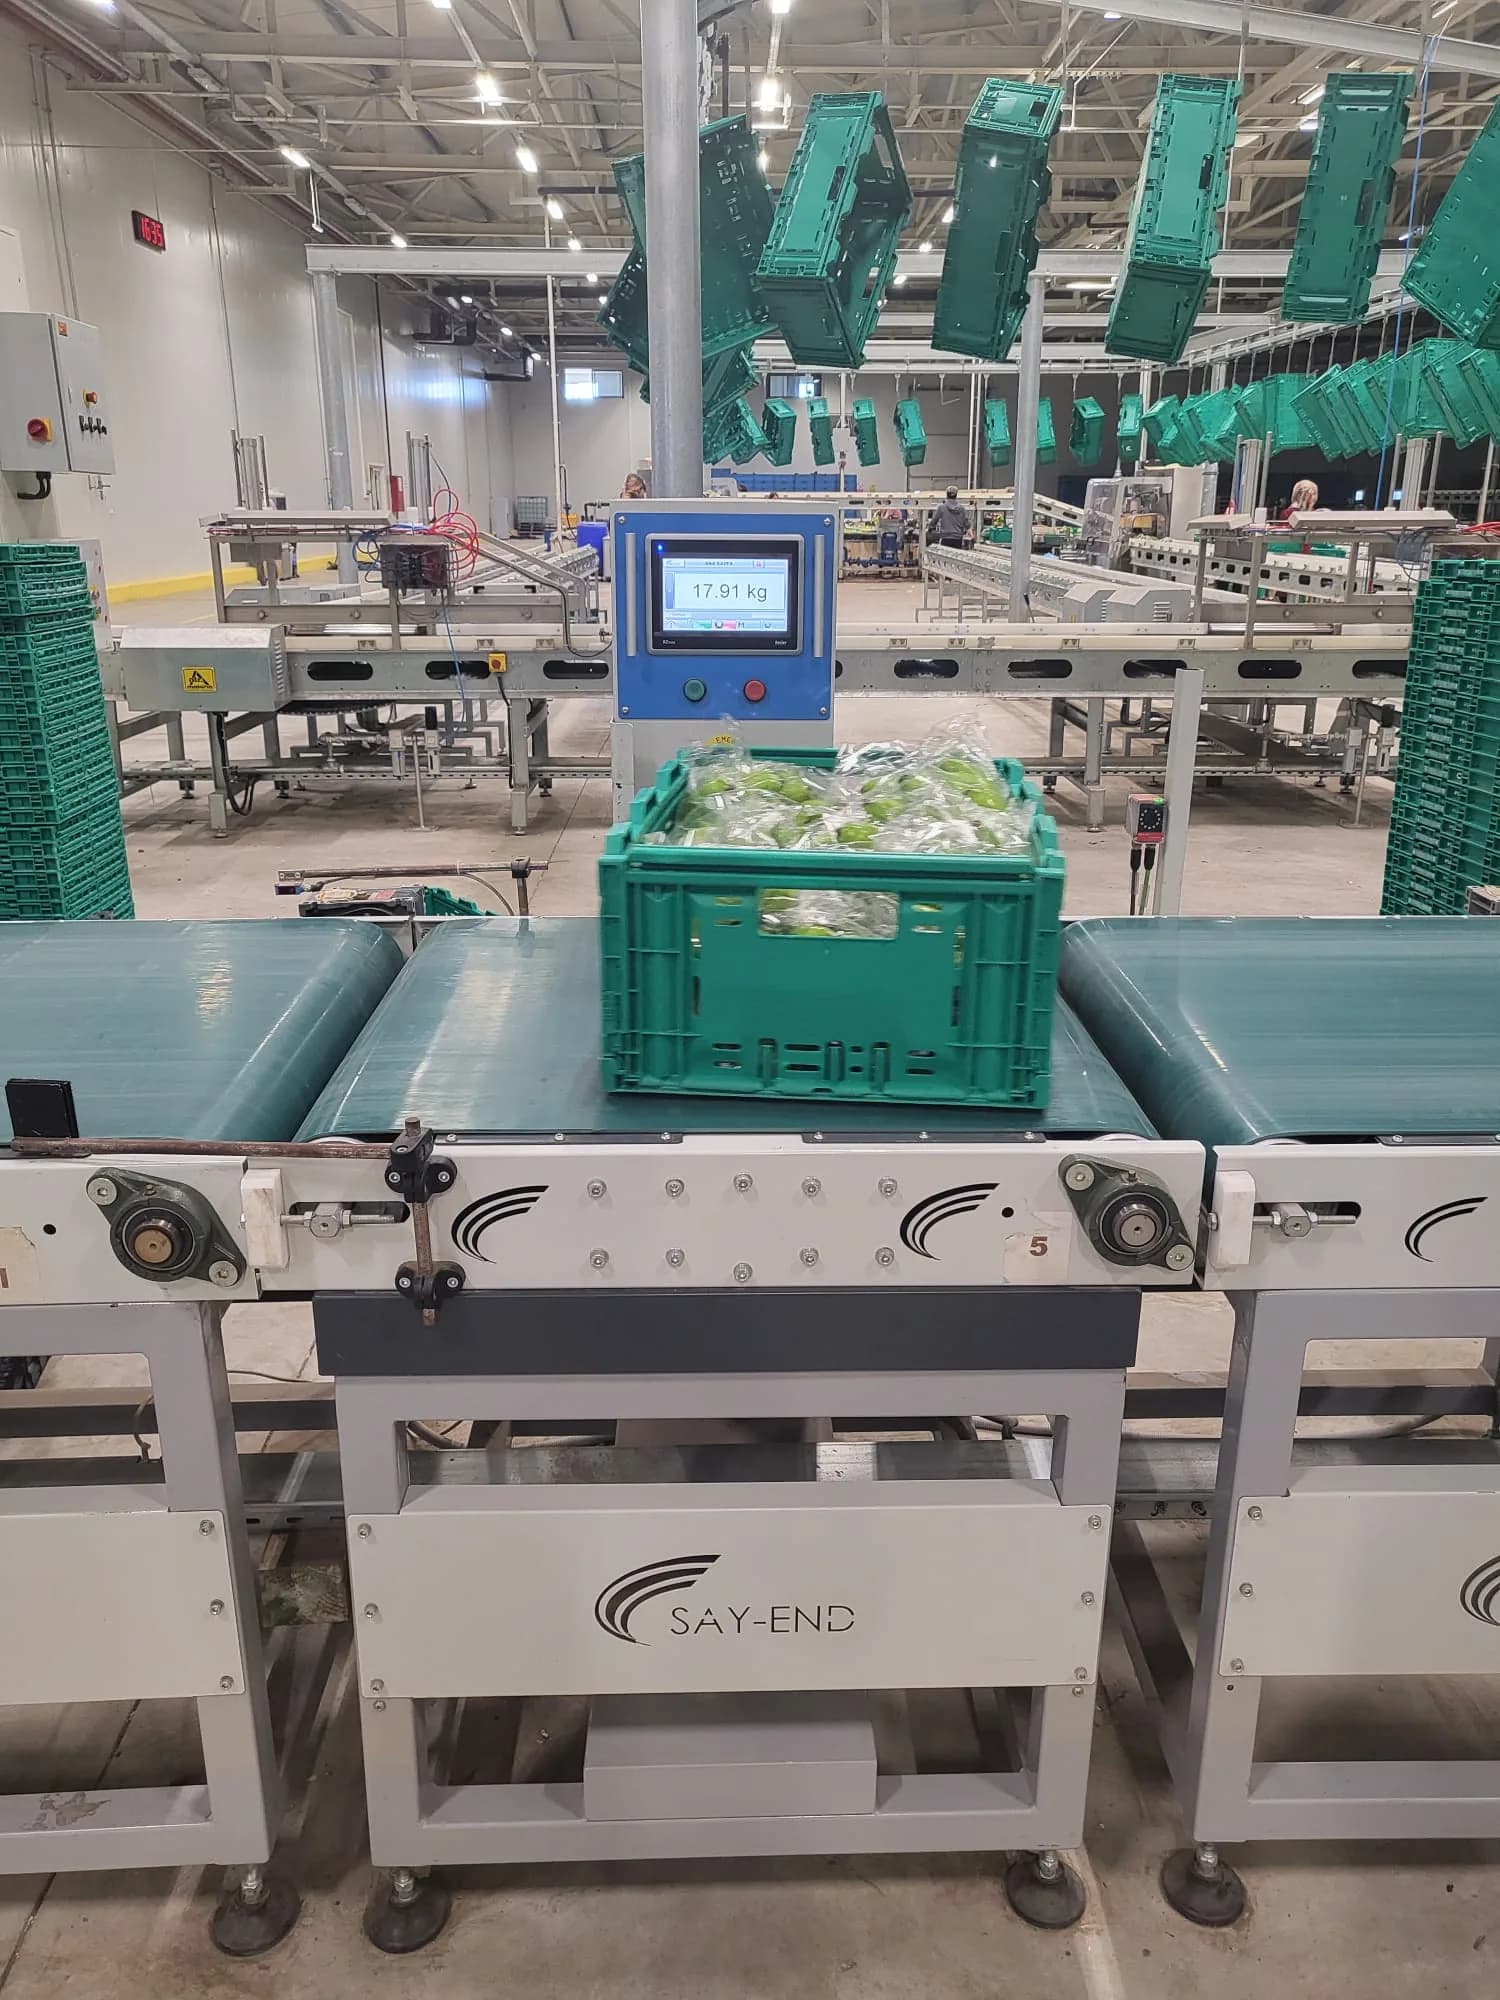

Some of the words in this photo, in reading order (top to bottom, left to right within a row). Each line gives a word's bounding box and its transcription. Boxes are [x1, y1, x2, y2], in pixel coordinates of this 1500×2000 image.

[693, 583, 738, 599] 17.91
[747, 584, 767, 602] kg
[1029, 1235, 1048, 1257] 5
[670, 1605, 855, 1635] SAY-END
